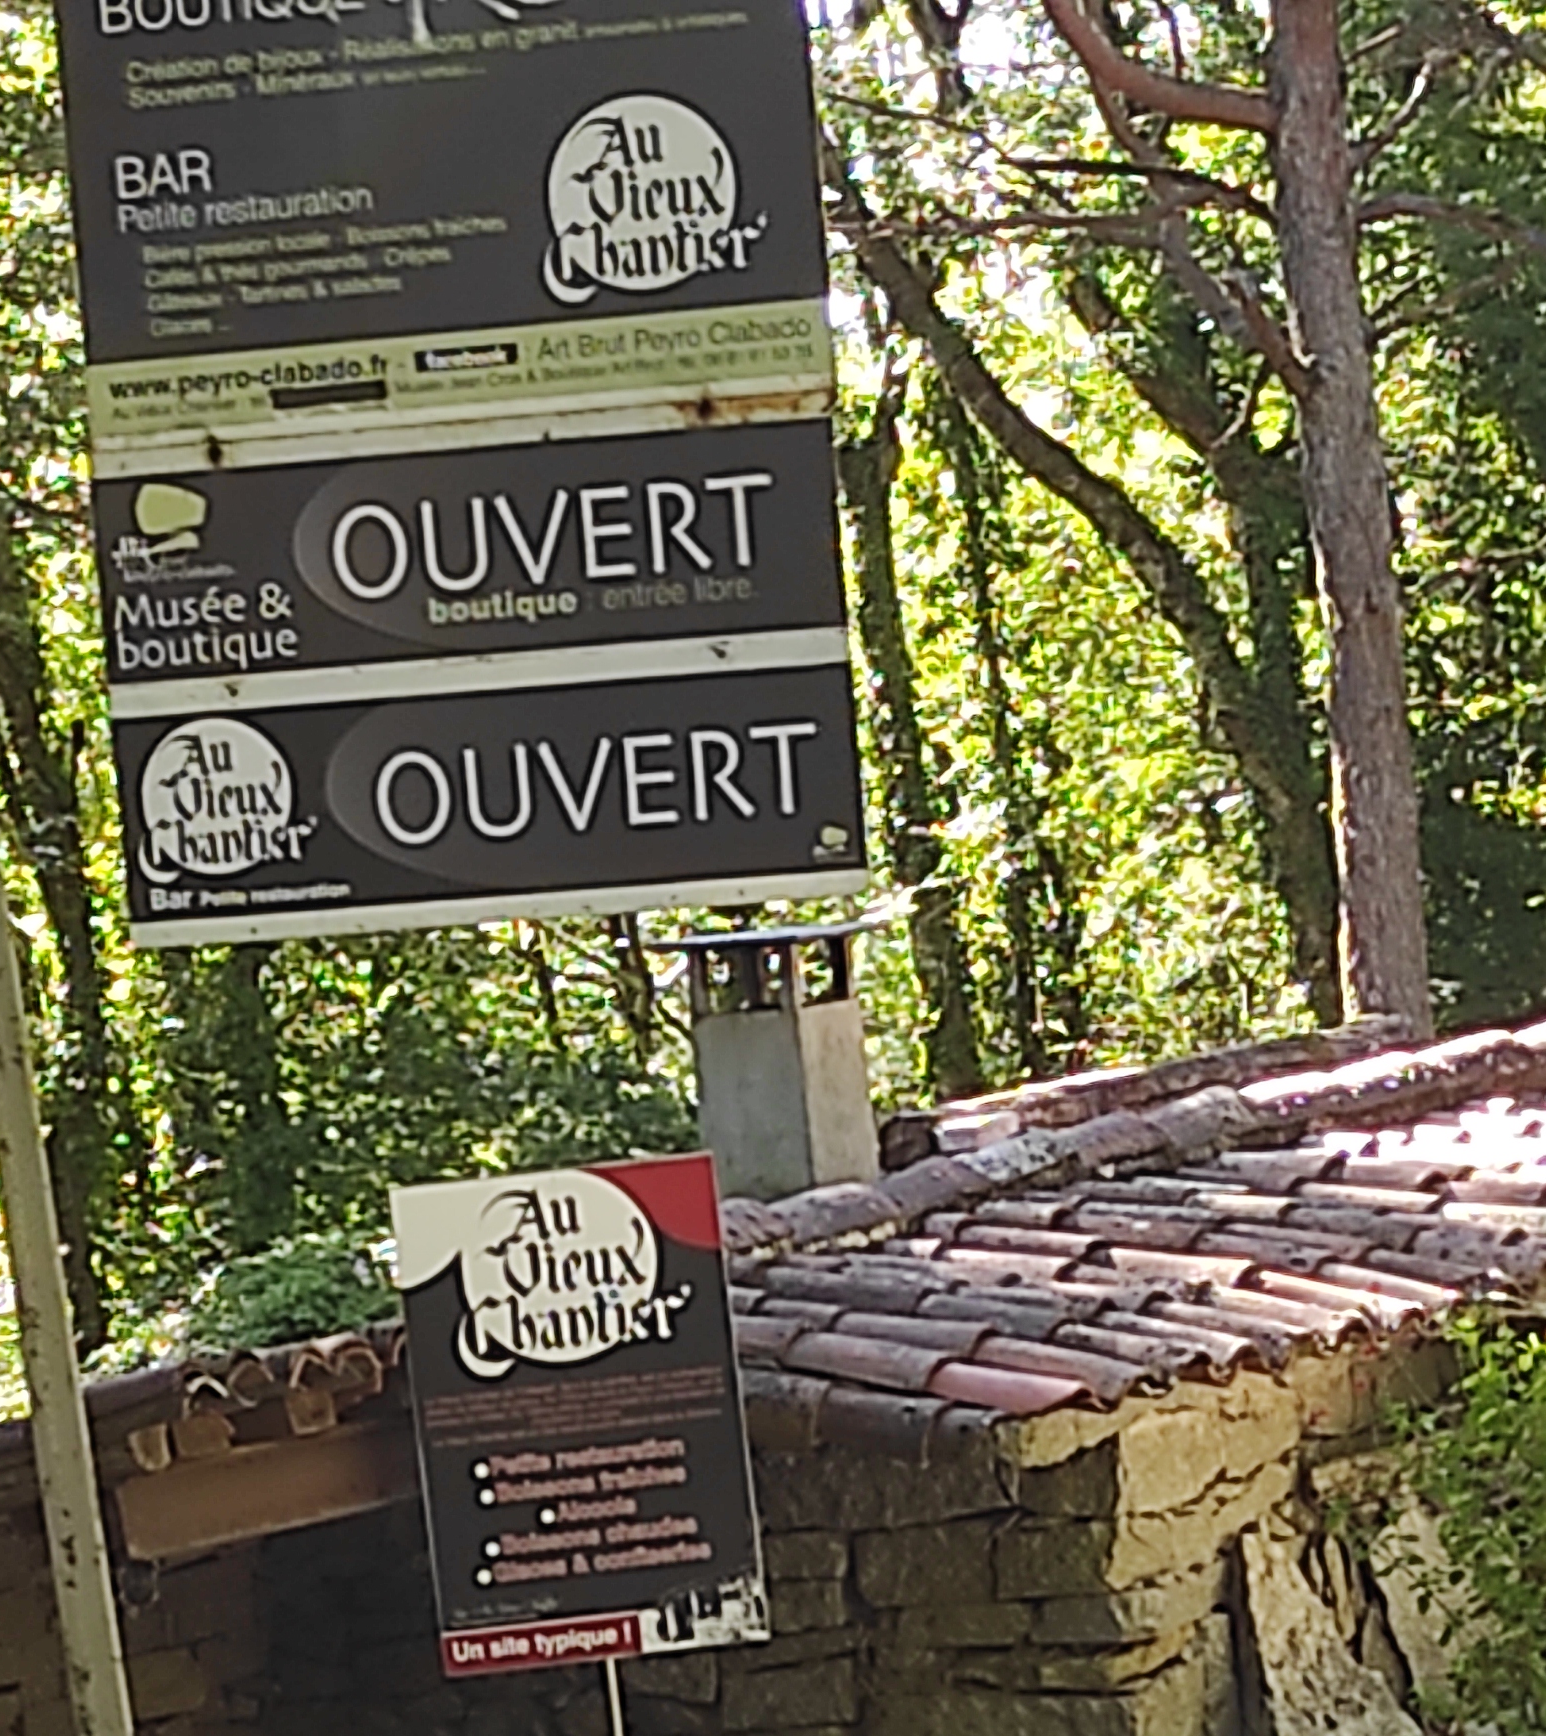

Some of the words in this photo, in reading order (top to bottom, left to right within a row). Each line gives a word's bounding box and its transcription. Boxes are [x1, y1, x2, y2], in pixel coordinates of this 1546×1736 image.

[126, 58, 219, 84] Création
[223, 54, 253, 76] de
[257, 50, 324, 76] bijoux
[480, 30, 511, 50] en
[128, 80, 238, 109] Souvenirs
[255, 70, 355, 96] Minéraux
[570, 114, 664, 168] Au
[113, 150, 213, 200] BAR
[572, 147, 726, 224] Vieux
[118, 202, 198, 234] Petite
[205, 186, 375, 227] restauration
[543, 212, 768, 304] Chantier
[108, 354, 388, 400] www.peyro-clabado.fr
[537, 336, 572, 361] Art
[578, 330, 629, 357] Brut
[634, 327, 701, 354] Peyro
[708, 316, 812, 346] Clabado
[332, 473, 773, 600] OUVERT
[114, 585, 247, 631] Musée
[258, 582, 293, 621] &
[428, 589, 578, 625] boutique
[602, 576, 687, 610] entrée
[117, 627, 299, 671] boutique
[163, 734, 233, 777] Au
[158, 760, 283, 821] Vieux
[376, 722, 817, 845] OUVERT
[138, 815, 318, 884] Chantier
[149, 887, 192, 911] Bar
[250, 882, 352, 904] restauration
[481, 1188, 581, 1241] Au
[481, 1216, 647, 1298] Vieux
[458, 1283, 691, 1378] Chantier
[489, 1452, 552, 1477] Petite
[555, 1437, 686, 1471] restauration
[494, 1476, 596, 1502] Boissons
[557, 1495, 637, 1523] Alcools
[500, 1527, 601, 1555] Boissons
[605, 1515, 699, 1544] chaudes
[492, 1558, 569, 1583] Glaces
[571, 1552, 591, 1574] &
[593, 1541, 712, 1572] confiseries
[452, 1640, 485, 1663] Un
[490, 1635, 530, 1657] site
[534, 1627, 619, 1657] typique
